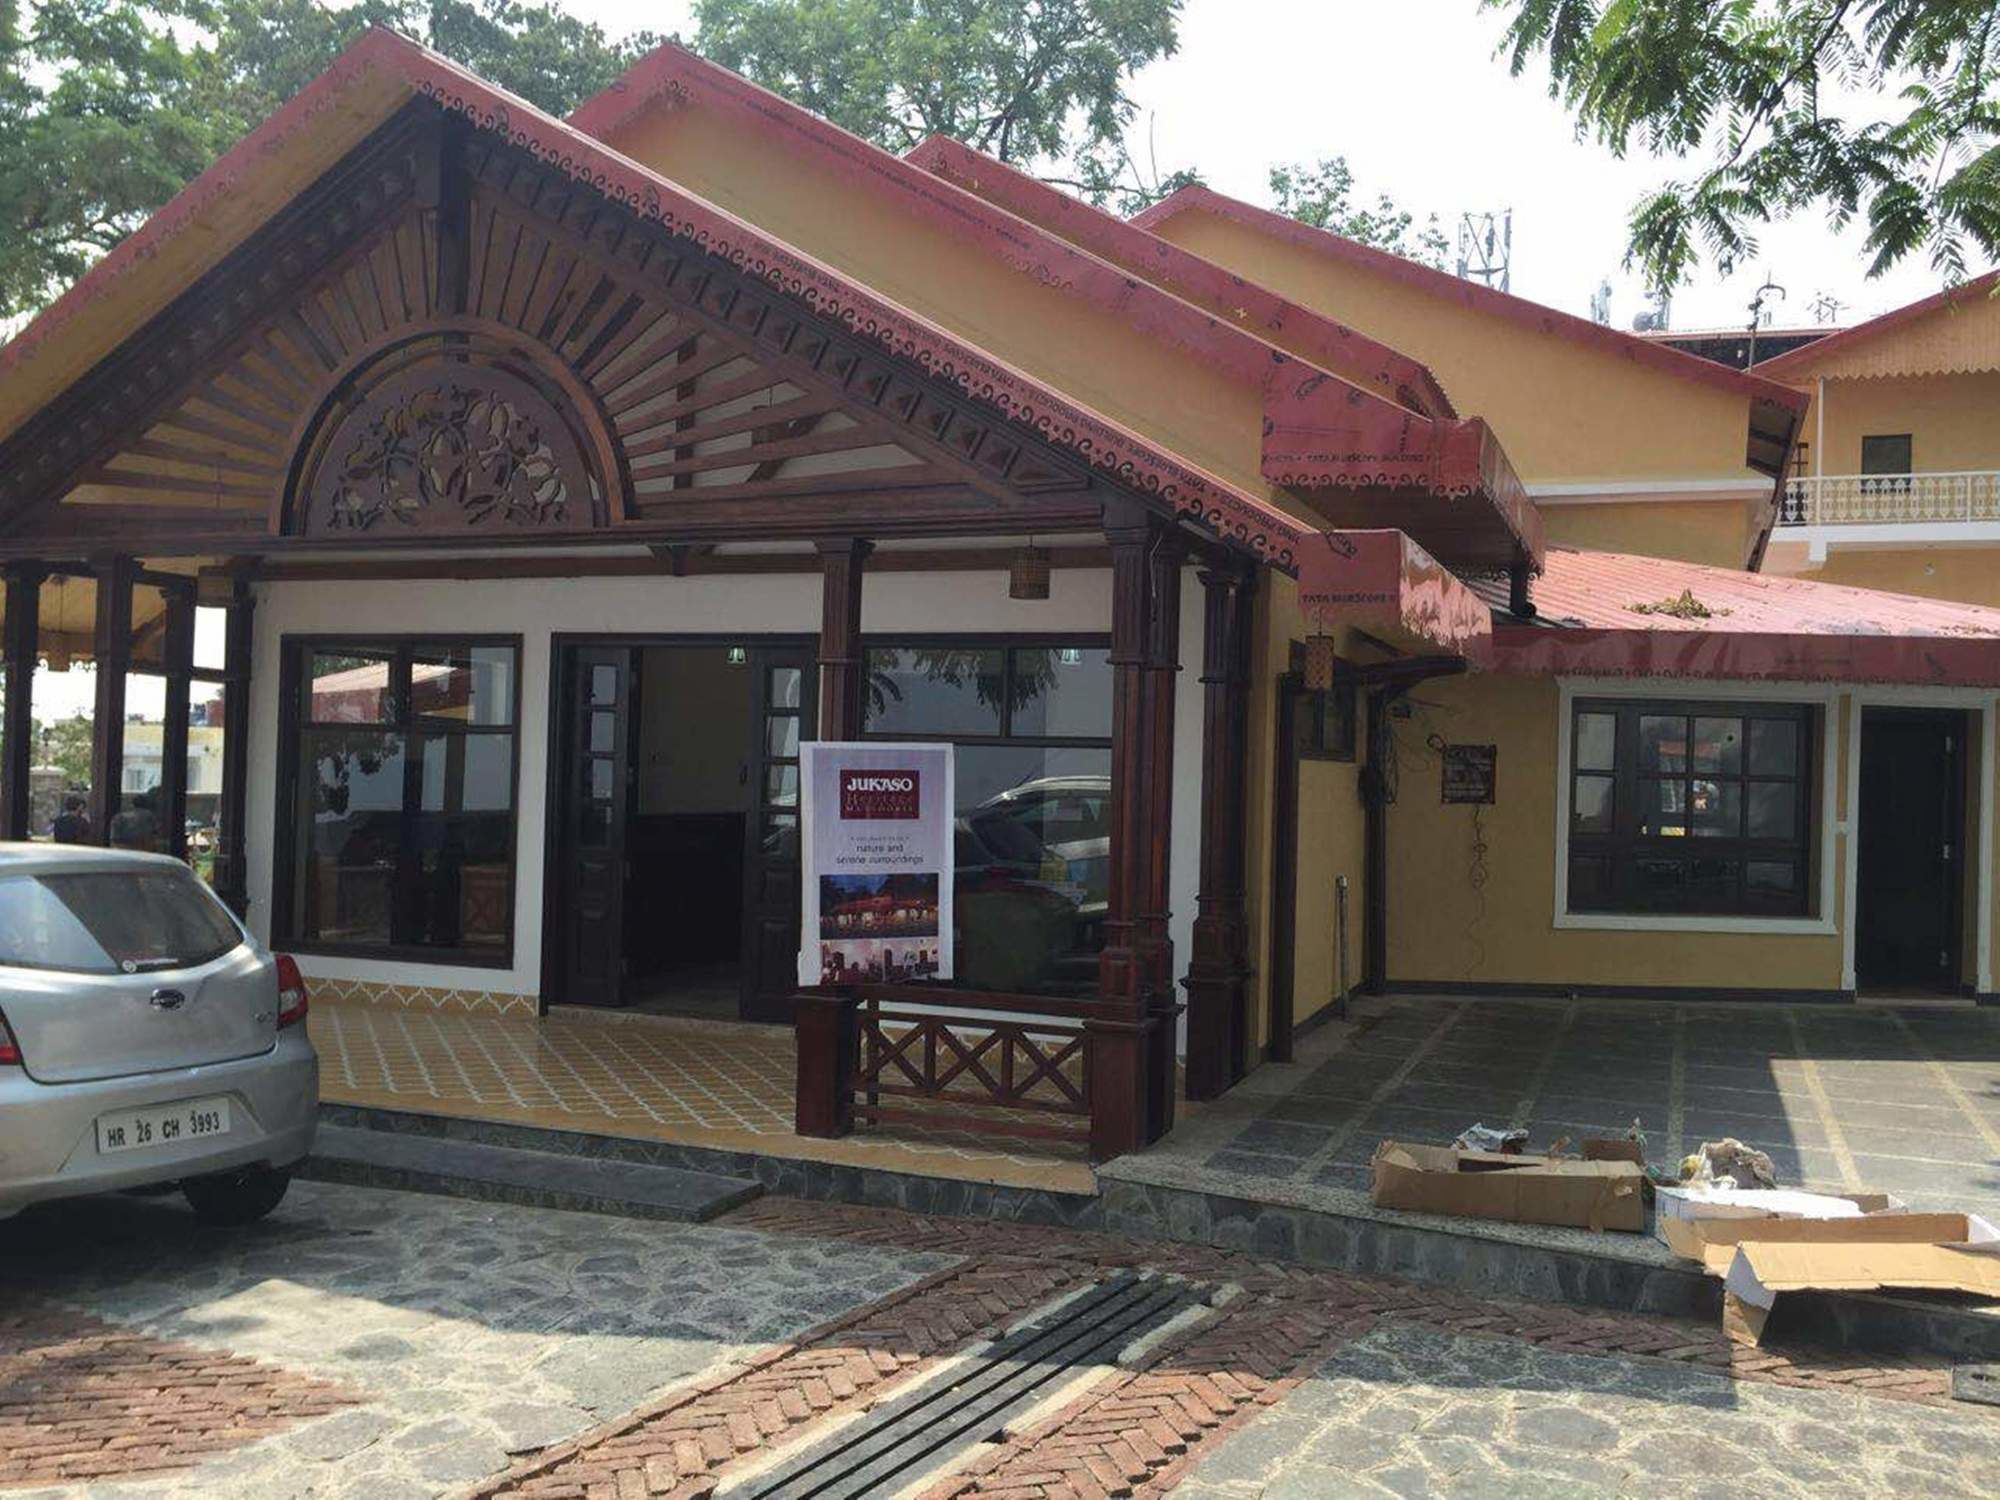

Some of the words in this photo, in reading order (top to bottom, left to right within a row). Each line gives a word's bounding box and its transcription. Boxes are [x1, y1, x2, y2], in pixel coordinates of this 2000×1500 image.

[846, 777, 913, 792] JUKASO
[887, 844, 904, 852] and
[107, 1127, 126, 1147] HR
[136, 1121, 152, 1143] 26
[162, 1119, 180, 1139] CH
[190, 1112, 220, 1134] 3993
